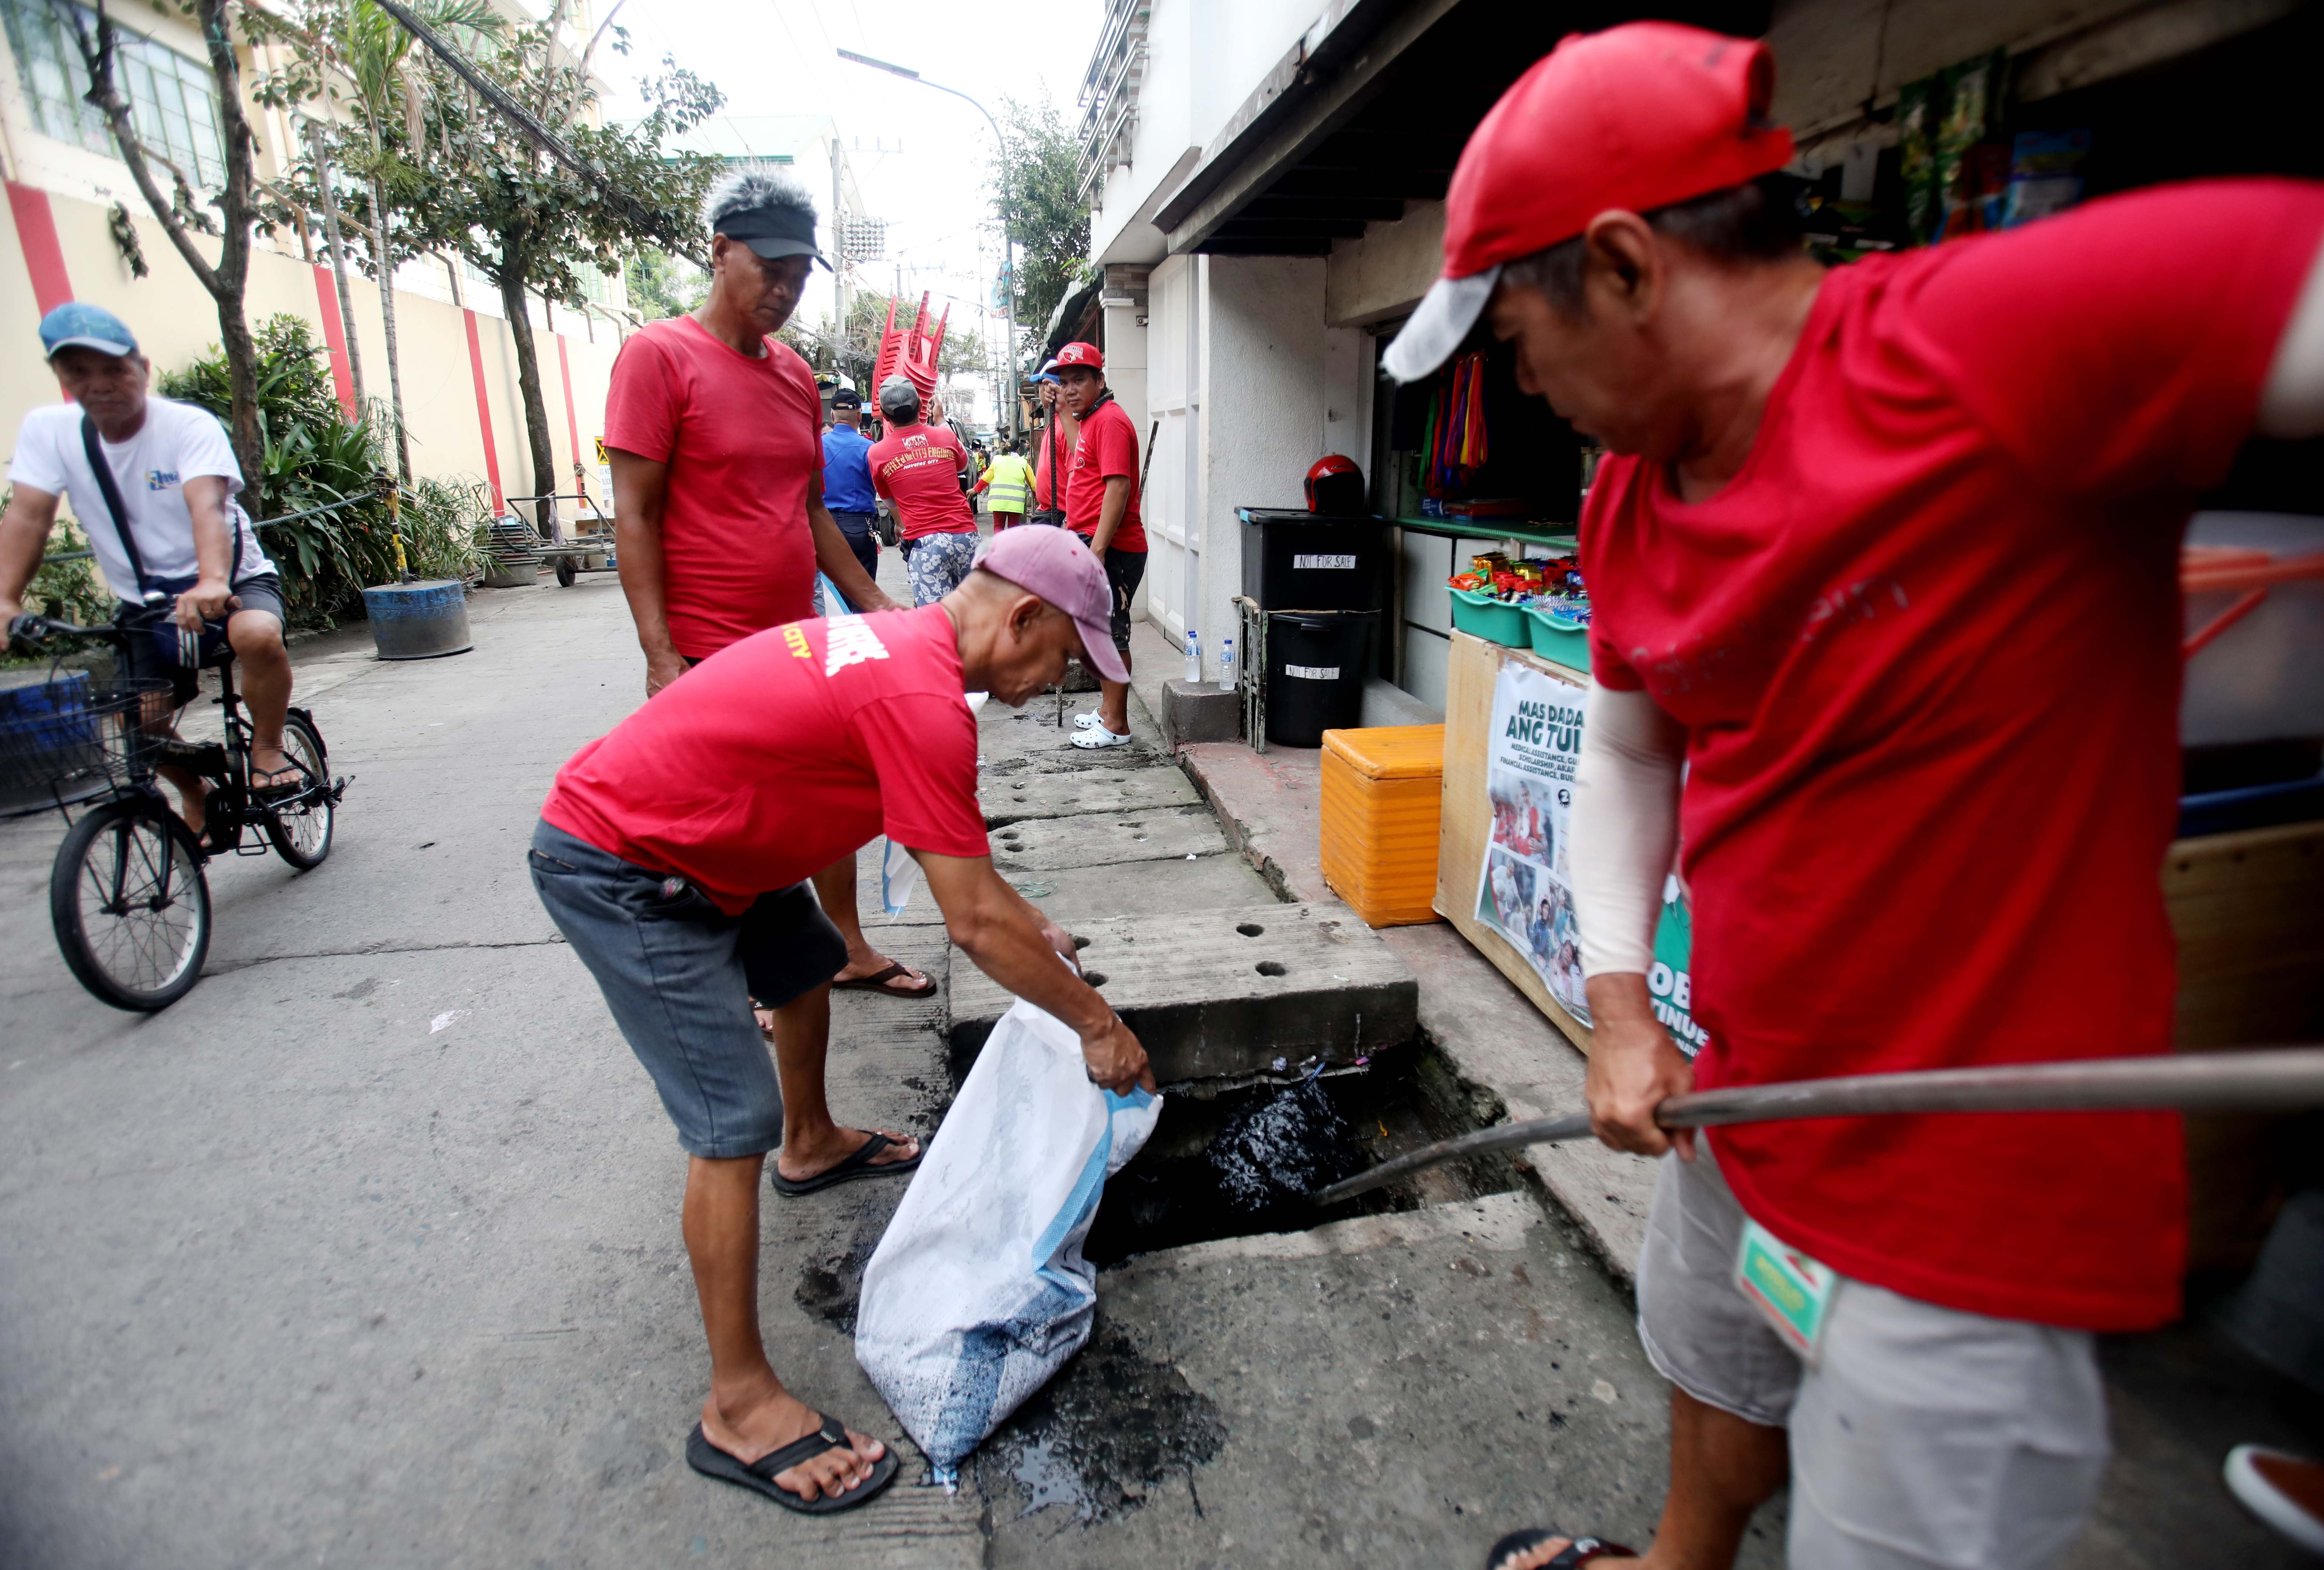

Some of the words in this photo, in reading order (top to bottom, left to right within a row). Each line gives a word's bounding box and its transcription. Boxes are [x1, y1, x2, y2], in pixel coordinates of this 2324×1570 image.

[883, 456, 903, 477] OFFICE
[900, 453, 906, 463] of
[905, 452, 913, 461] the
[911, 447, 927, 460] CITY
[903, 461, 926, 470] NAVOTAS
[1300, 555, 1314, 568] NOT
[1317, 555, 1332, 568] FOR
[1334, 555, 1352, 568] SALE
[783, 628, 811, 659] CITY
[1290, 666, 1301, 677] NOT
[1305, 667, 1317, 678] FOR
[1320, 668, 1336, 679] SALE
[1519, 699, 1546, 720] MAS
[1549, 705, 1585, 728] DADA
[1506, 715, 1545, 745] ANG
[1500, 756, 1523, 770] FINANCIAL
[1511, 743, 1531, 754] MEDICAL
[1568, 757, 1580, 766] GU
